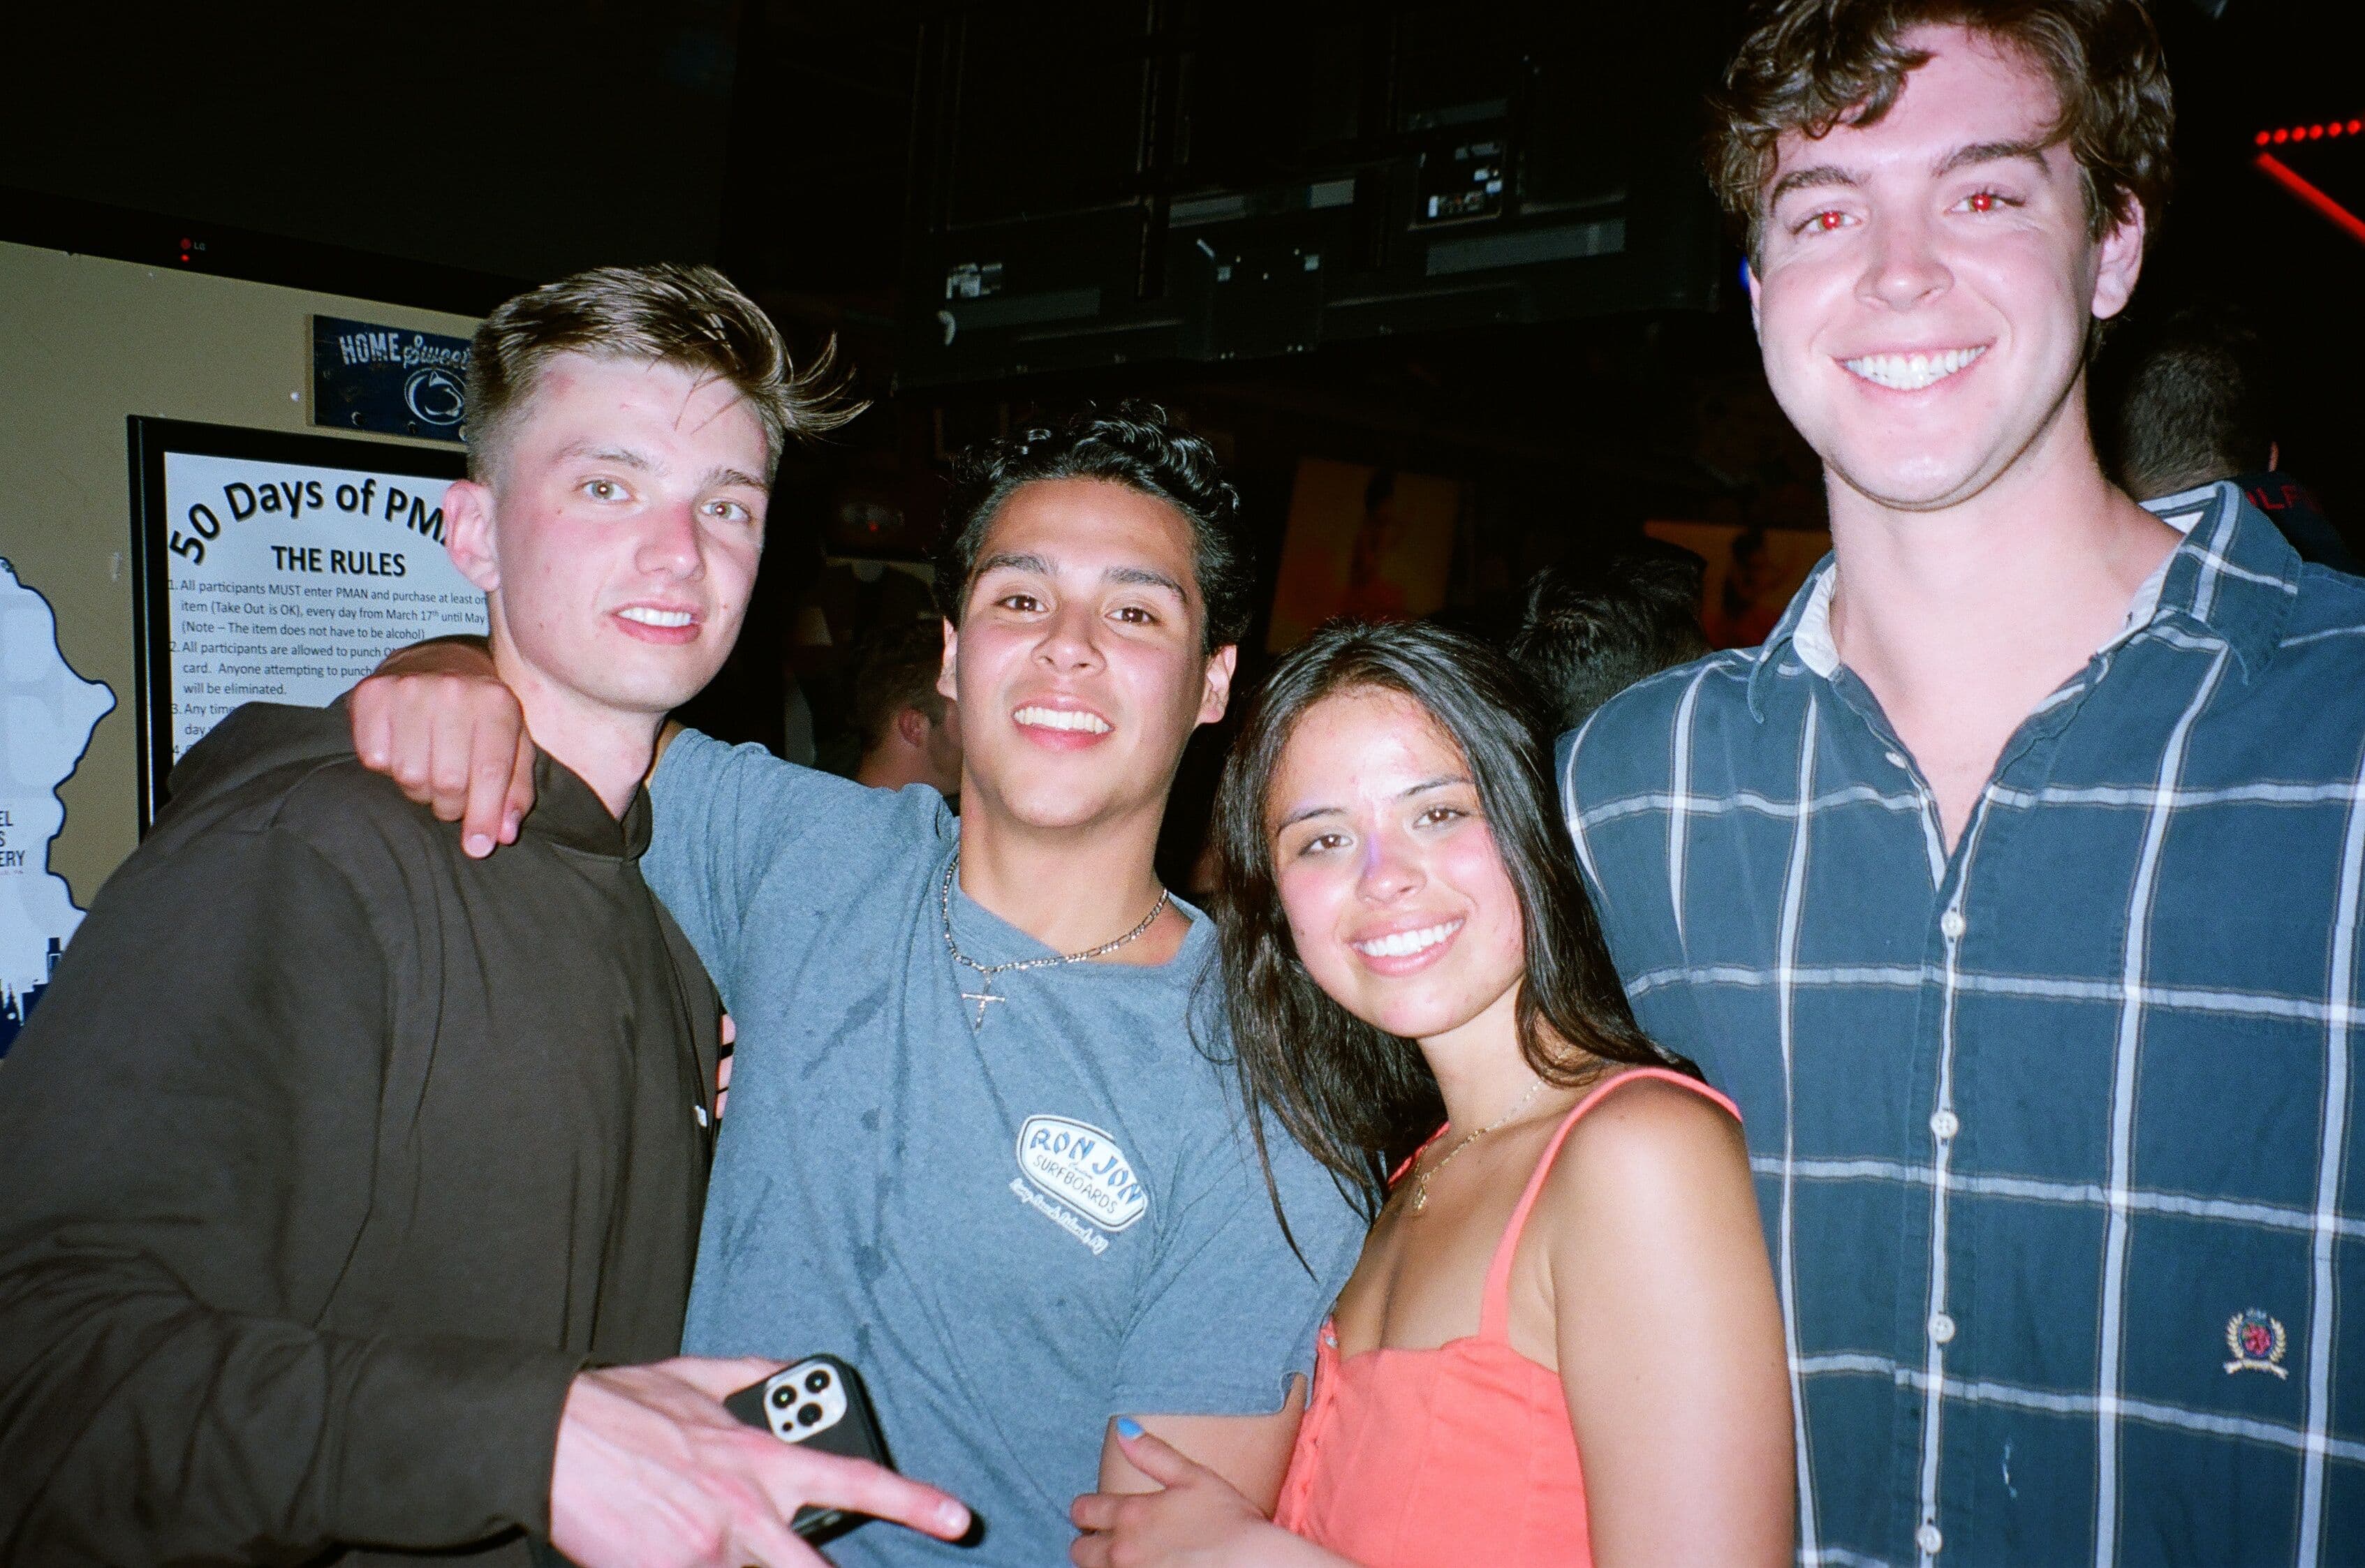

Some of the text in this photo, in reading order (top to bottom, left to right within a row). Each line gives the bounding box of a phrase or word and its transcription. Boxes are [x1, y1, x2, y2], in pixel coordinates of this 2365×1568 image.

[193, 240, 207, 251] LG
[339, 332, 402, 365] HOME
[169, 478, 446, 565] 50 Days of PM
[270, 545, 406, 577] THE RULES
[168, 579, 178, 591] 1.
[180, 579, 196, 591] All
[199, 581, 266, 594] participants
[268, 584, 301, 596] MUST
[304, 586, 333, 598] enter
[335, 587, 369, 599] PMAN
[371, 590, 390, 600] and
[392, 591, 436, 604] purchase
[439, 593, 448, 604] at
[450, 593, 473, 604] least
[181, 600, 486, 625] item (Take Out is OK), every day from March 17th until May
[182, 621, 214, 634] (Note
[228, 622, 249, 634] The
[251, 623, 278, 635] item
[280, 624, 306, 636] does
[309, 626, 327, 637] not
[330, 626, 355, 637] have
[357, 627, 369, 638] to
[371, 627, 383, 638] be
[385, 628, 425, 639] alcohol)
[182, 641, 198, 653] All
[200, 642, 267, 656] participants
[270, 646, 288, 655] are
[290, 644, 333, 656] allowed
[336, 646, 348, 657] to
[350, 646, 381, 658] punch
[182, 663, 372, 678] card. Anyone attempting to punch
[183, 682, 287, 695] will be eliminated.
[171, 703, 183, 714] 3.
[184, 703, 206, 716] Any
[185, 723, 206, 737] day
[1029, 1127, 1096, 1161] RON
[1092, 1154, 1143, 1206] JON
[1033, 1154, 1118, 1214] SURFBOARDS
